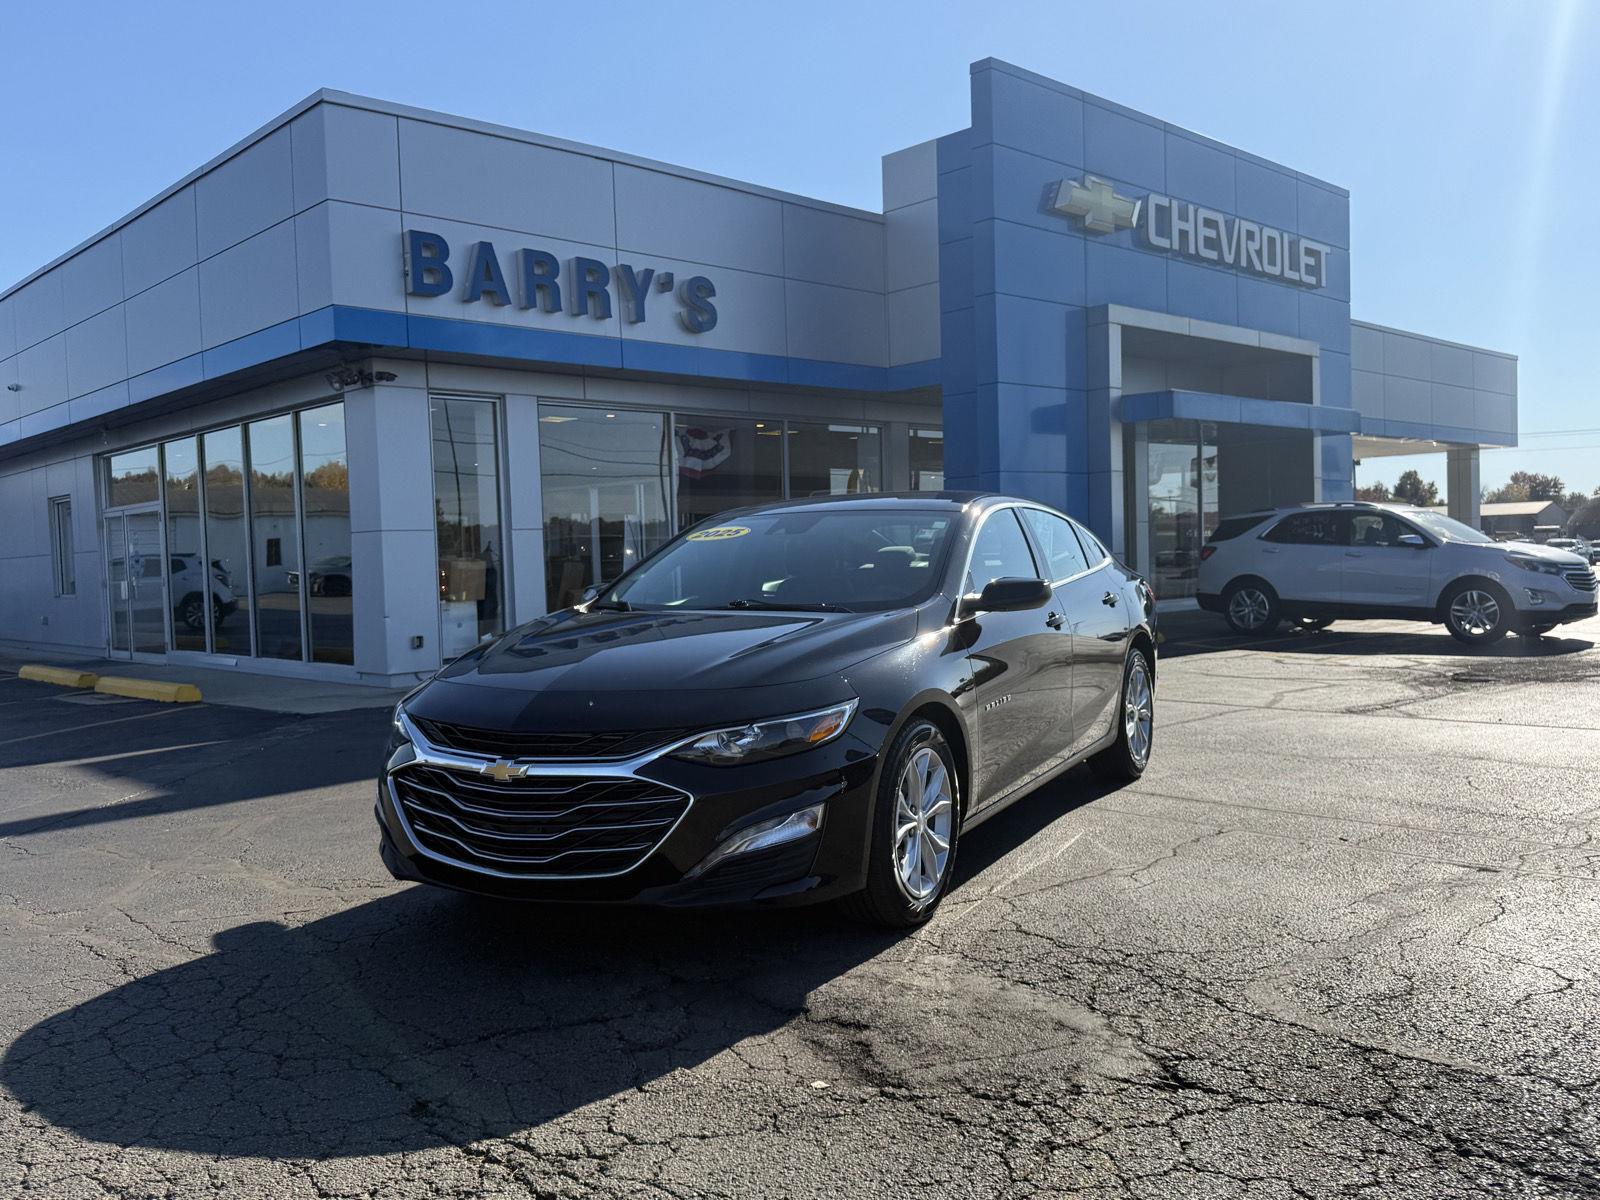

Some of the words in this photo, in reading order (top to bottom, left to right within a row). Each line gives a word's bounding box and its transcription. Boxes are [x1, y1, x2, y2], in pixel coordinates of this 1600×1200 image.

[404, 229, 718, 334] BARRY'S
[1148, 193, 1331, 287] CHEVROLET
[690, 528, 746, 539] 2025
